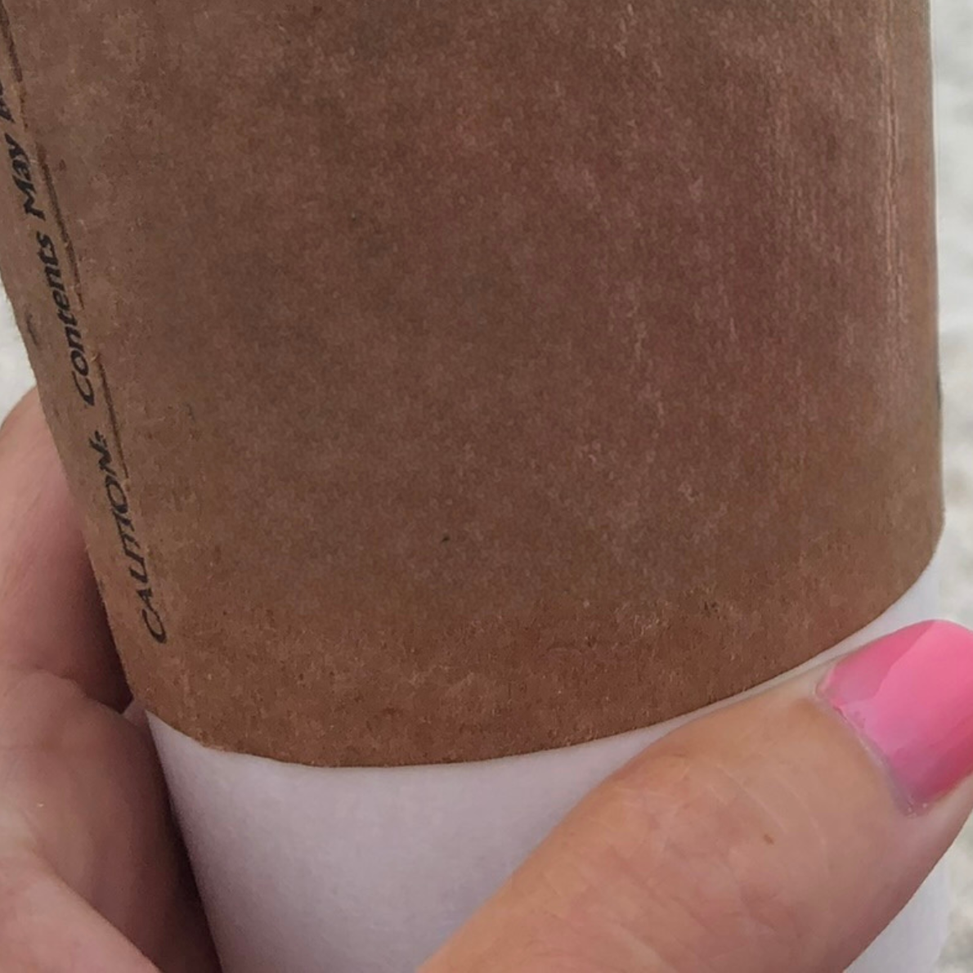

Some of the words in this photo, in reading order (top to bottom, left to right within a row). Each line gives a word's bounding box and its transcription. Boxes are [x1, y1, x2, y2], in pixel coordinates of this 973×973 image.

[4, 132, 46, 221] May
[36, 231, 95, 406] Contents
[89, 430, 167, 644] CAUTION:
